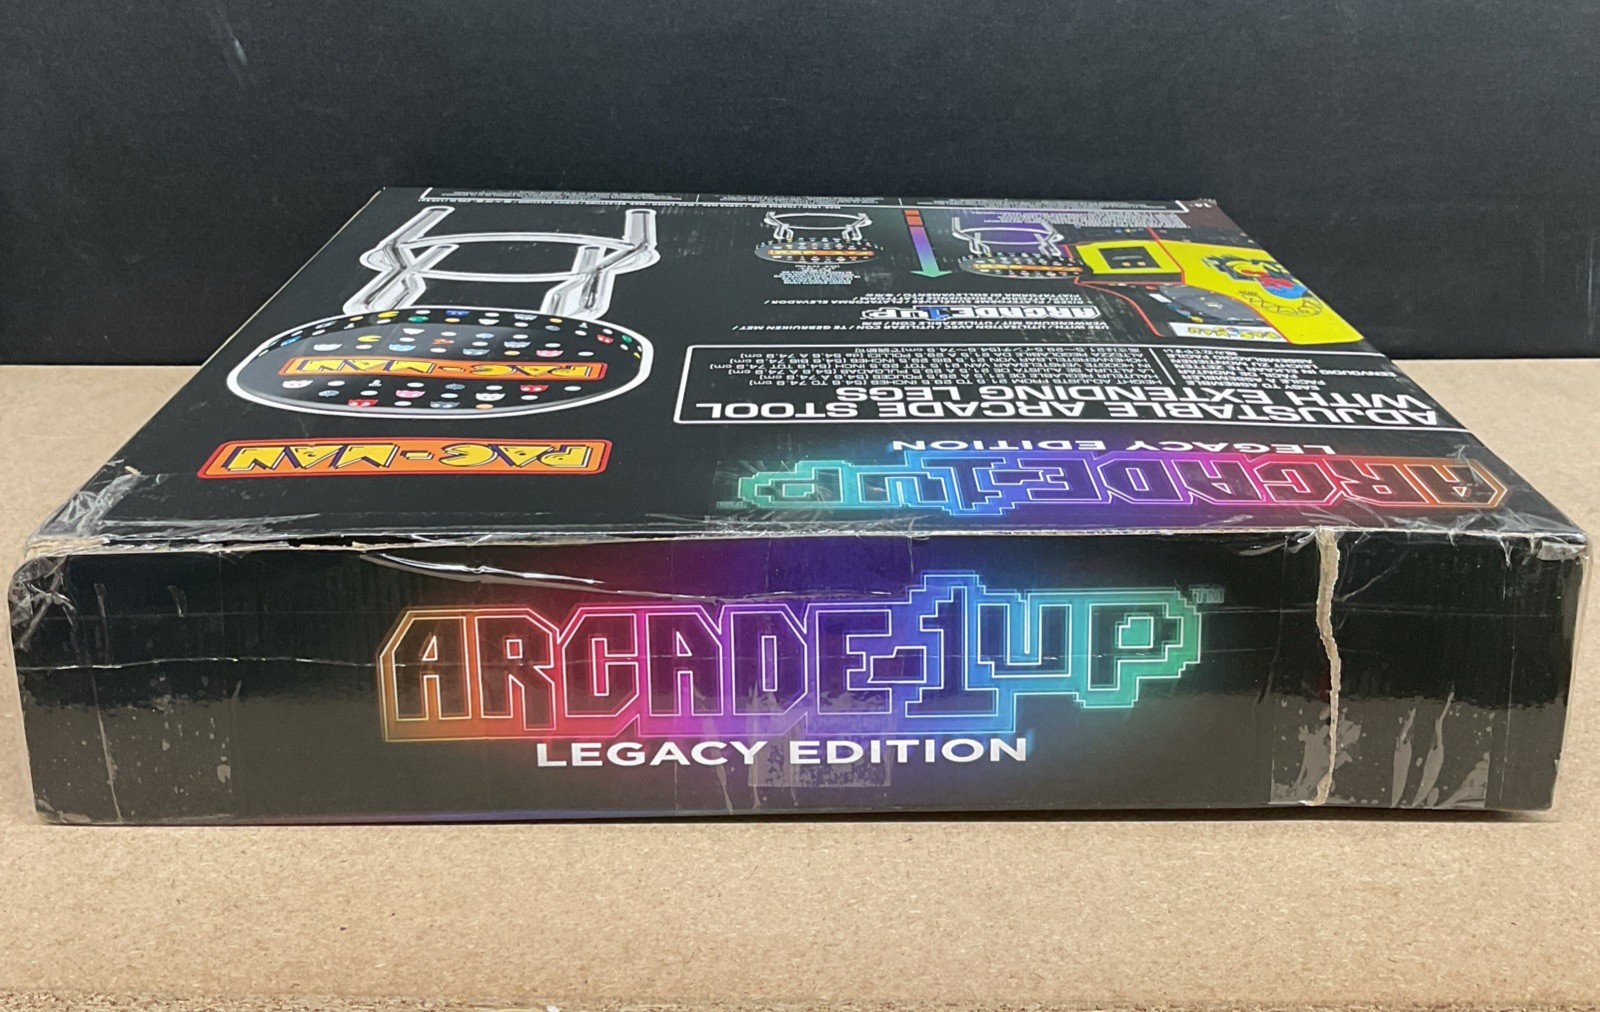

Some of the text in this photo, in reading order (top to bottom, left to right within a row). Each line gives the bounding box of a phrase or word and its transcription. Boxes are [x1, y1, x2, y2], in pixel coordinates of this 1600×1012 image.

[296, 360, 592, 378] PAC-MAN
[1213, 355, 1312, 364] ASSEMBLAGGIO
[836, 386, 1431, 409] WITH EXTENDING LEGS
[696, 401, 1438, 425] ADJUSTABLE ARCADE STOOL
[221, 444, 592, 472] PAC-MAN
[893, 441, 1336, 454] LEGACY EDITION
[739, 451, 1508, 515] ARCADE1UP
[378, 570, 1201, 741] ARCADE1UP
[537, 738, 1026, 767] LEGACY EDITION
